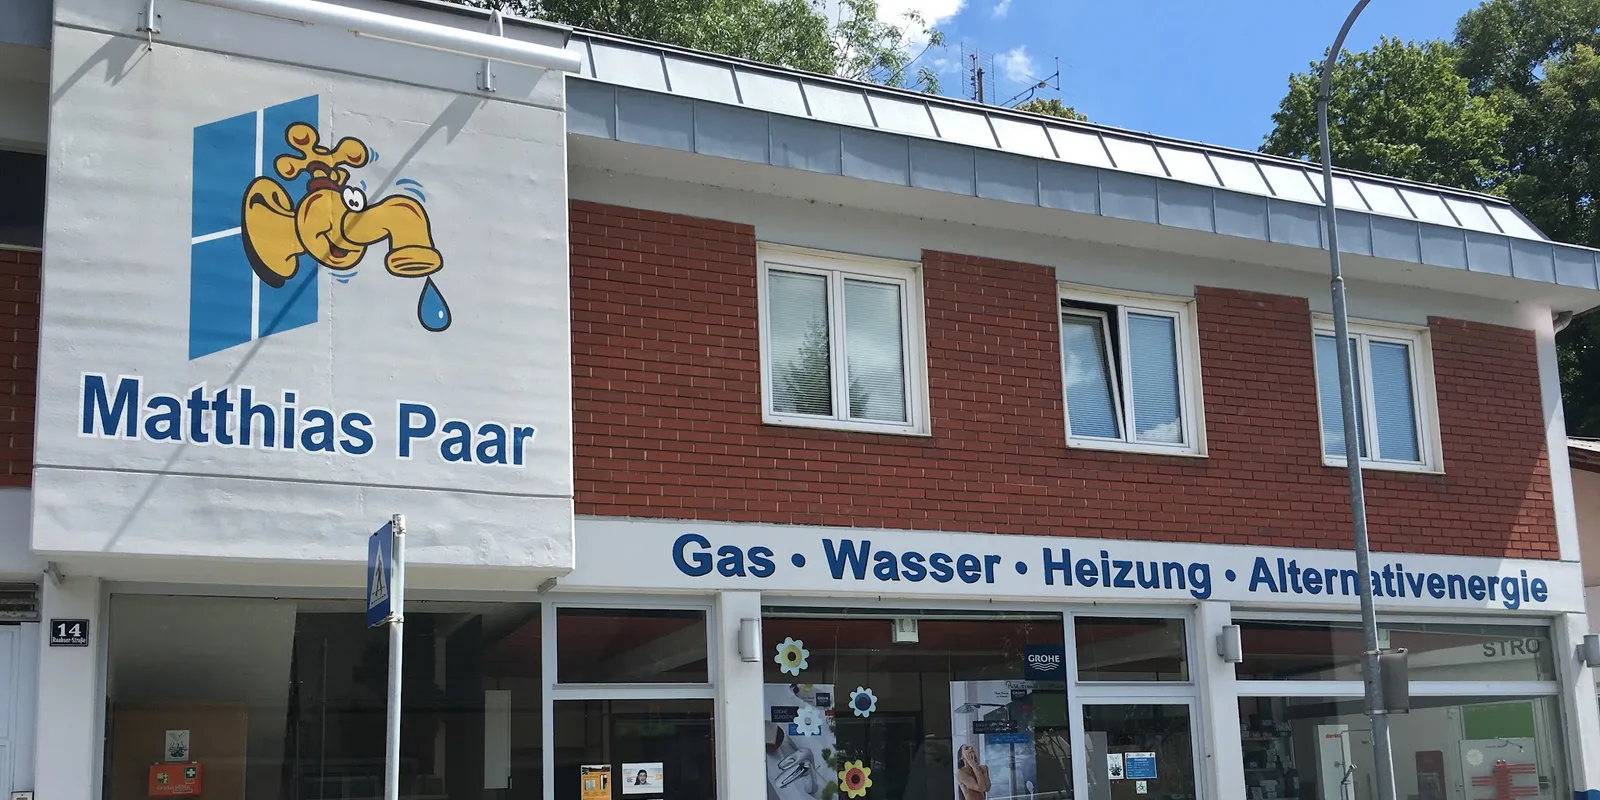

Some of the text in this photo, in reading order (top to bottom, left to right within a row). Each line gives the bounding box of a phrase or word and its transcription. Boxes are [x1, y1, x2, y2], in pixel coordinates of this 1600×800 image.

[82, 373, 535, 466] Matthias Paar
[672, 533, 1548, 610] Gas Wasser Heizung Alternativenergie
[58, 623, 81, 637] 14
[1028, 654, 1060, 663] GROHE
